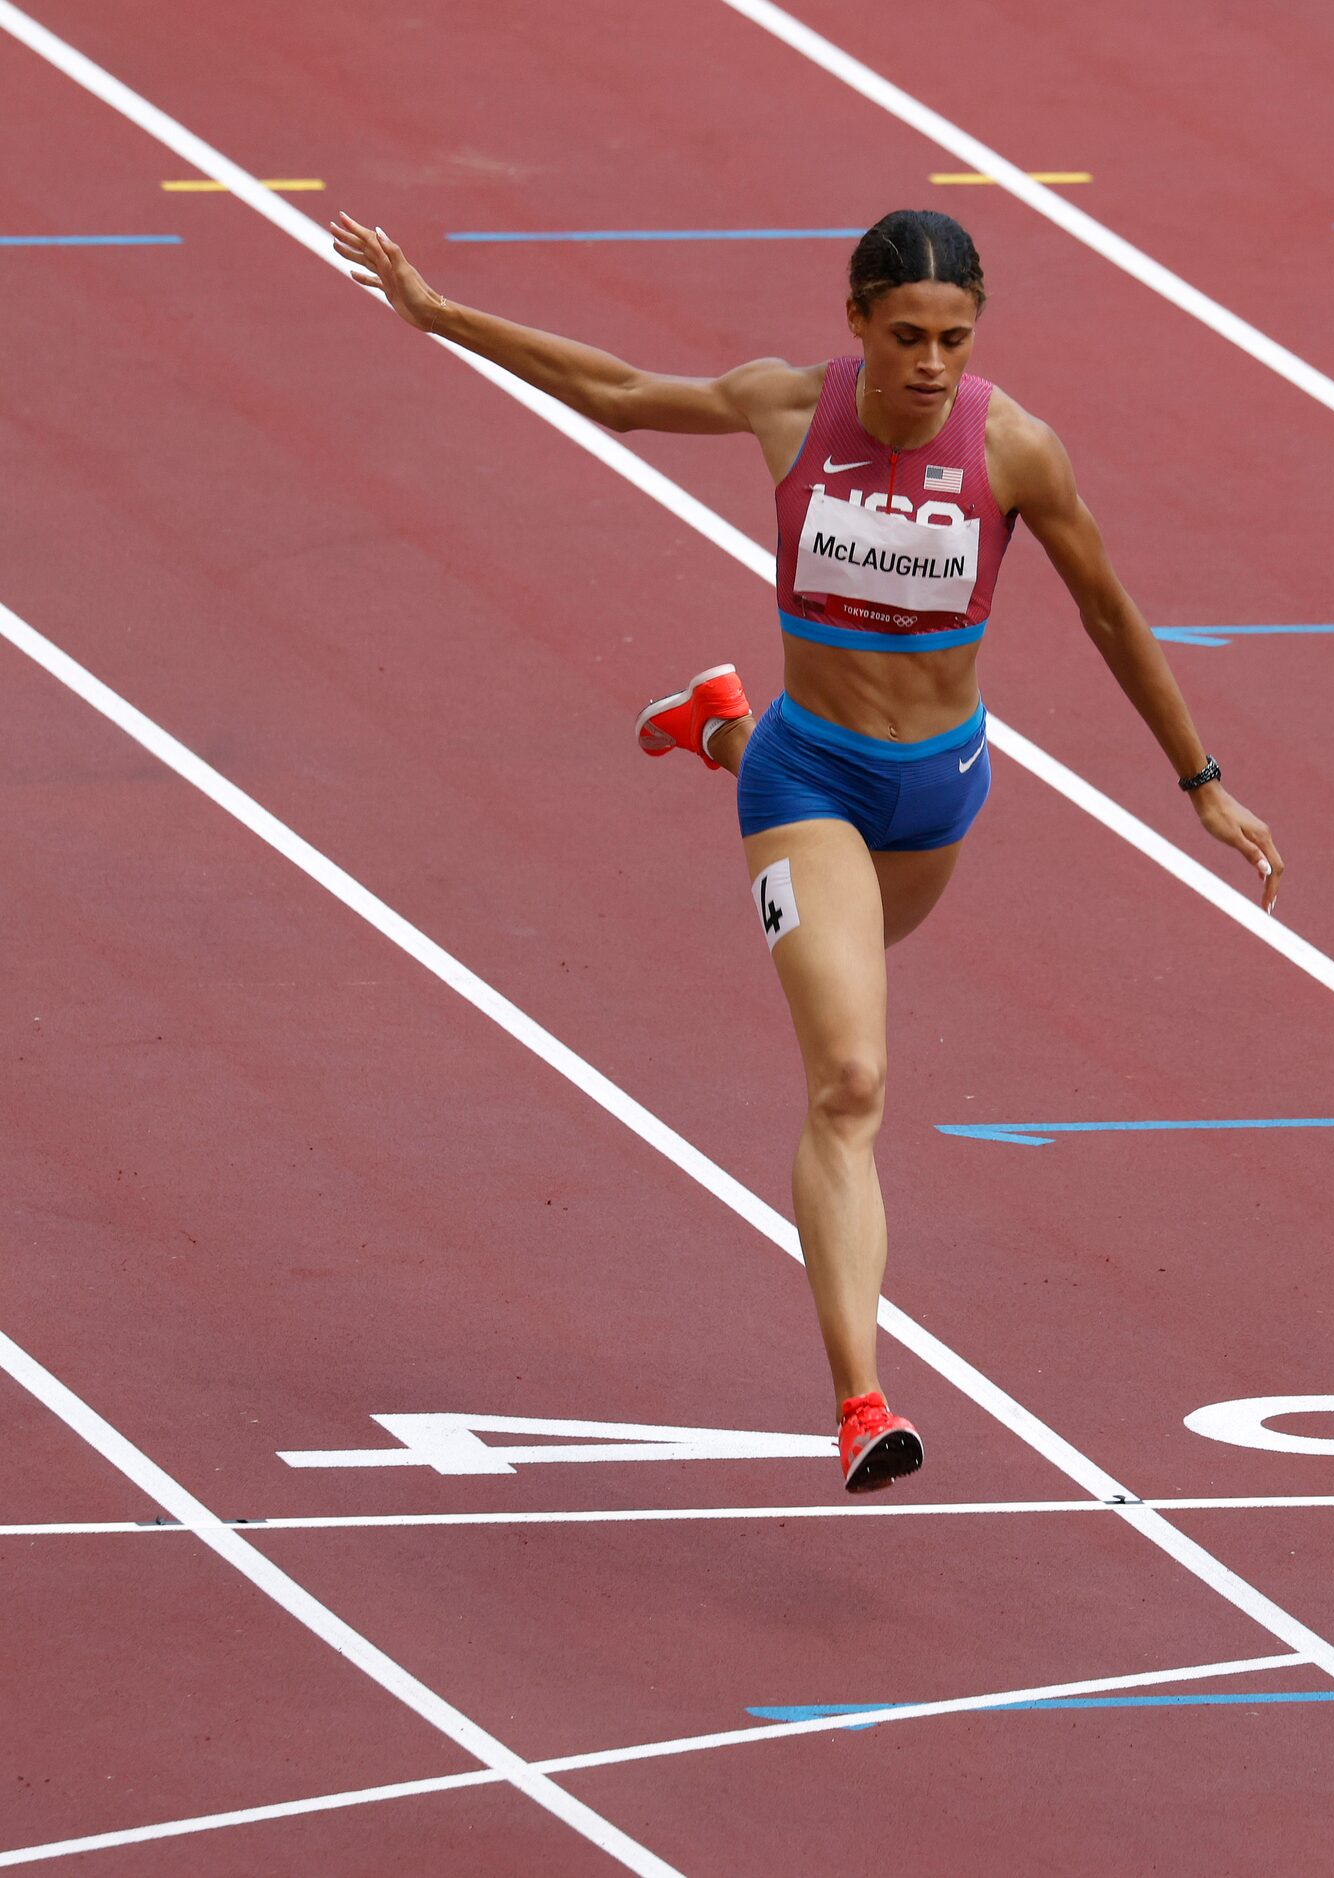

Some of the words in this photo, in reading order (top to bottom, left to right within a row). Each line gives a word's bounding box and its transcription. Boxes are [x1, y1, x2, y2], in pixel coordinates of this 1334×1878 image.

[812, 531, 965, 579] McLAUGHLIN
[843, 604, 869, 619] TOKYO
[870, 610, 891, 623] 2020
[760, 875, 783, 934] 4
[275, 1412, 840, 1475] 4
